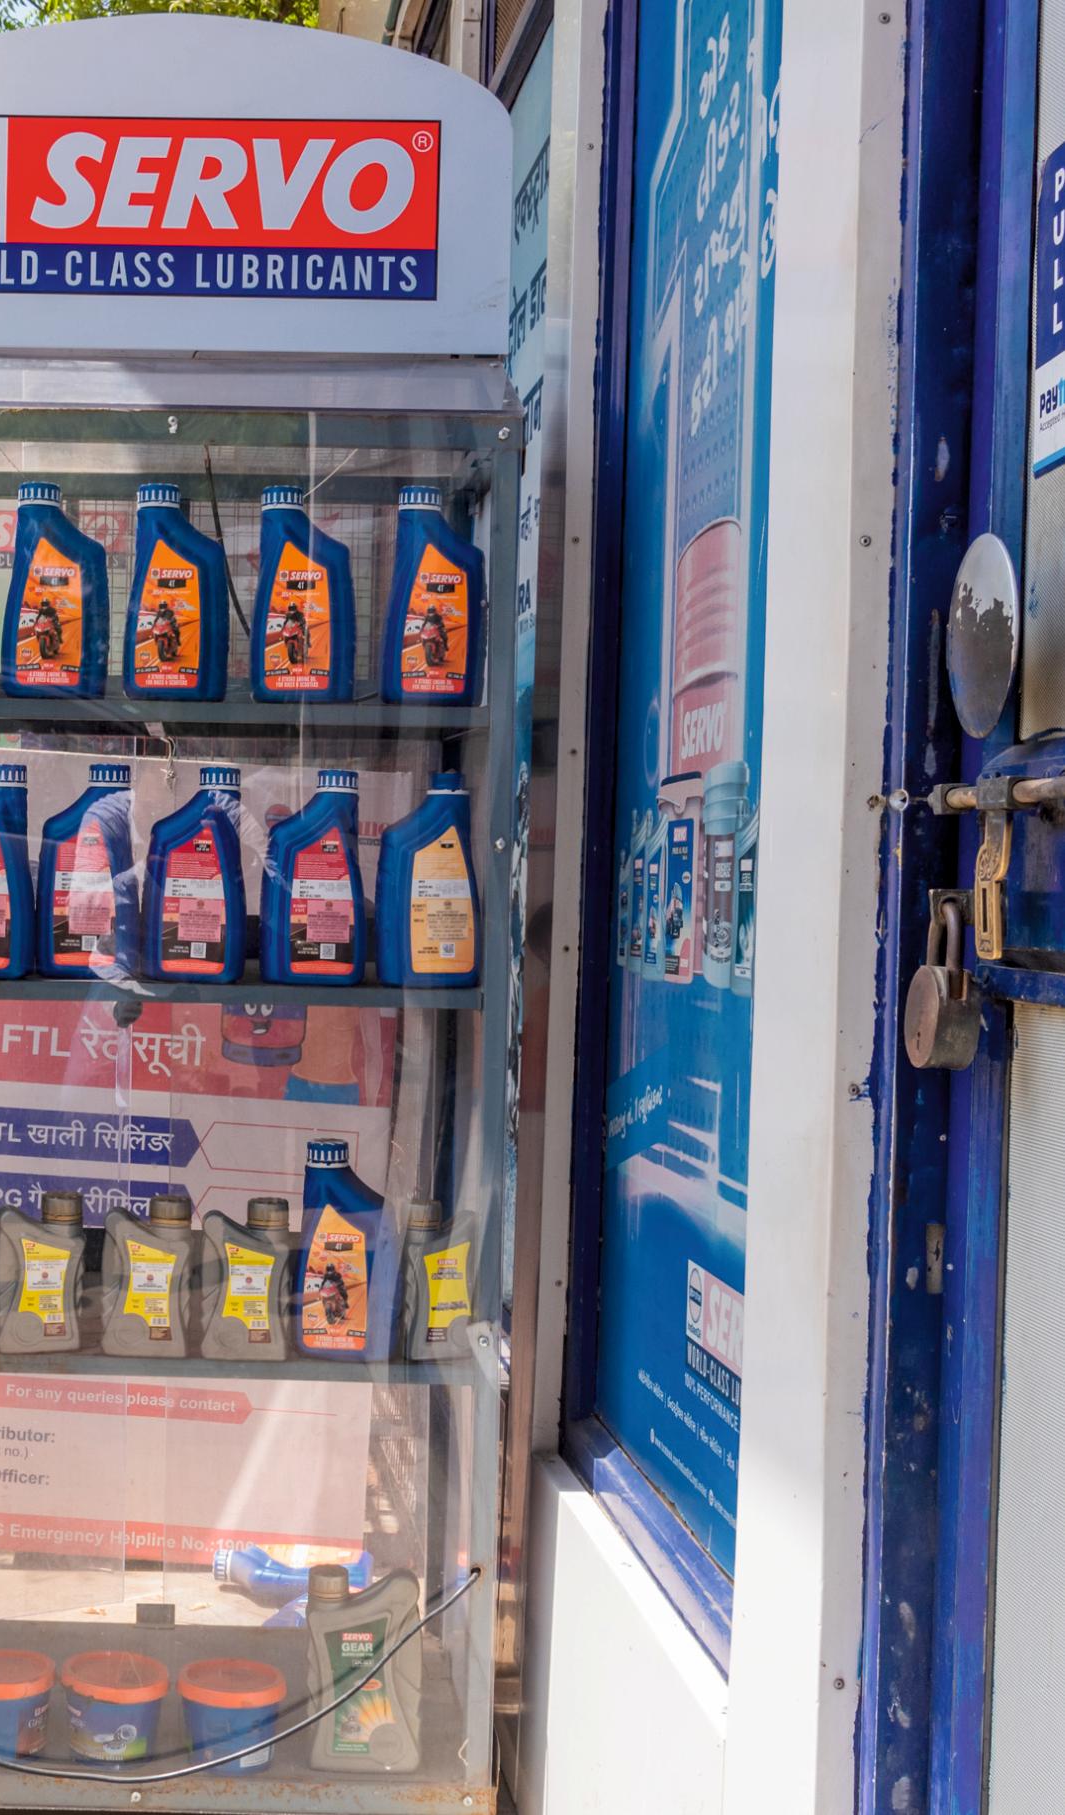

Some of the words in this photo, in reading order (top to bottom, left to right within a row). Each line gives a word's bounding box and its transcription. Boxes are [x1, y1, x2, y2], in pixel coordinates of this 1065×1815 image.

[30, 131, 415, 234] SERVO
[196, 253, 417, 292] LUBRICANTS
[44, 567, 75, 577] SERVO
[161, 569, 192, 579] SERVO
[290, 571, 322, 580] SERVO
[430, 574, 461, 584] SERVO
[680, 703, 727, 762] SERVO
[2, 1023, 71, 1057] FTL
[133, 1023, 206, 1078] सूची
[27, 1119, 87, 1147] खाली
[93, 1122, 175, 1152] सिलिंडर
[328, 1234, 360, 1243] SERVO
[6, 1385, 30, 1398] For
[35, 1388, 62, 1402] any
[67, 1390, 123, 1407] queries
[127, 1393, 175, 1410] please
[179, 1397, 236, 1412] contact
[4, 1444, 29, 1460] no.)
[10, 1525, 103, 1548] Emergency
[110, 1530, 176, 1549] Helpline
[342, 1632, 371, 1641] SERVO
[341, 1642, 373, 1652] GEAR
